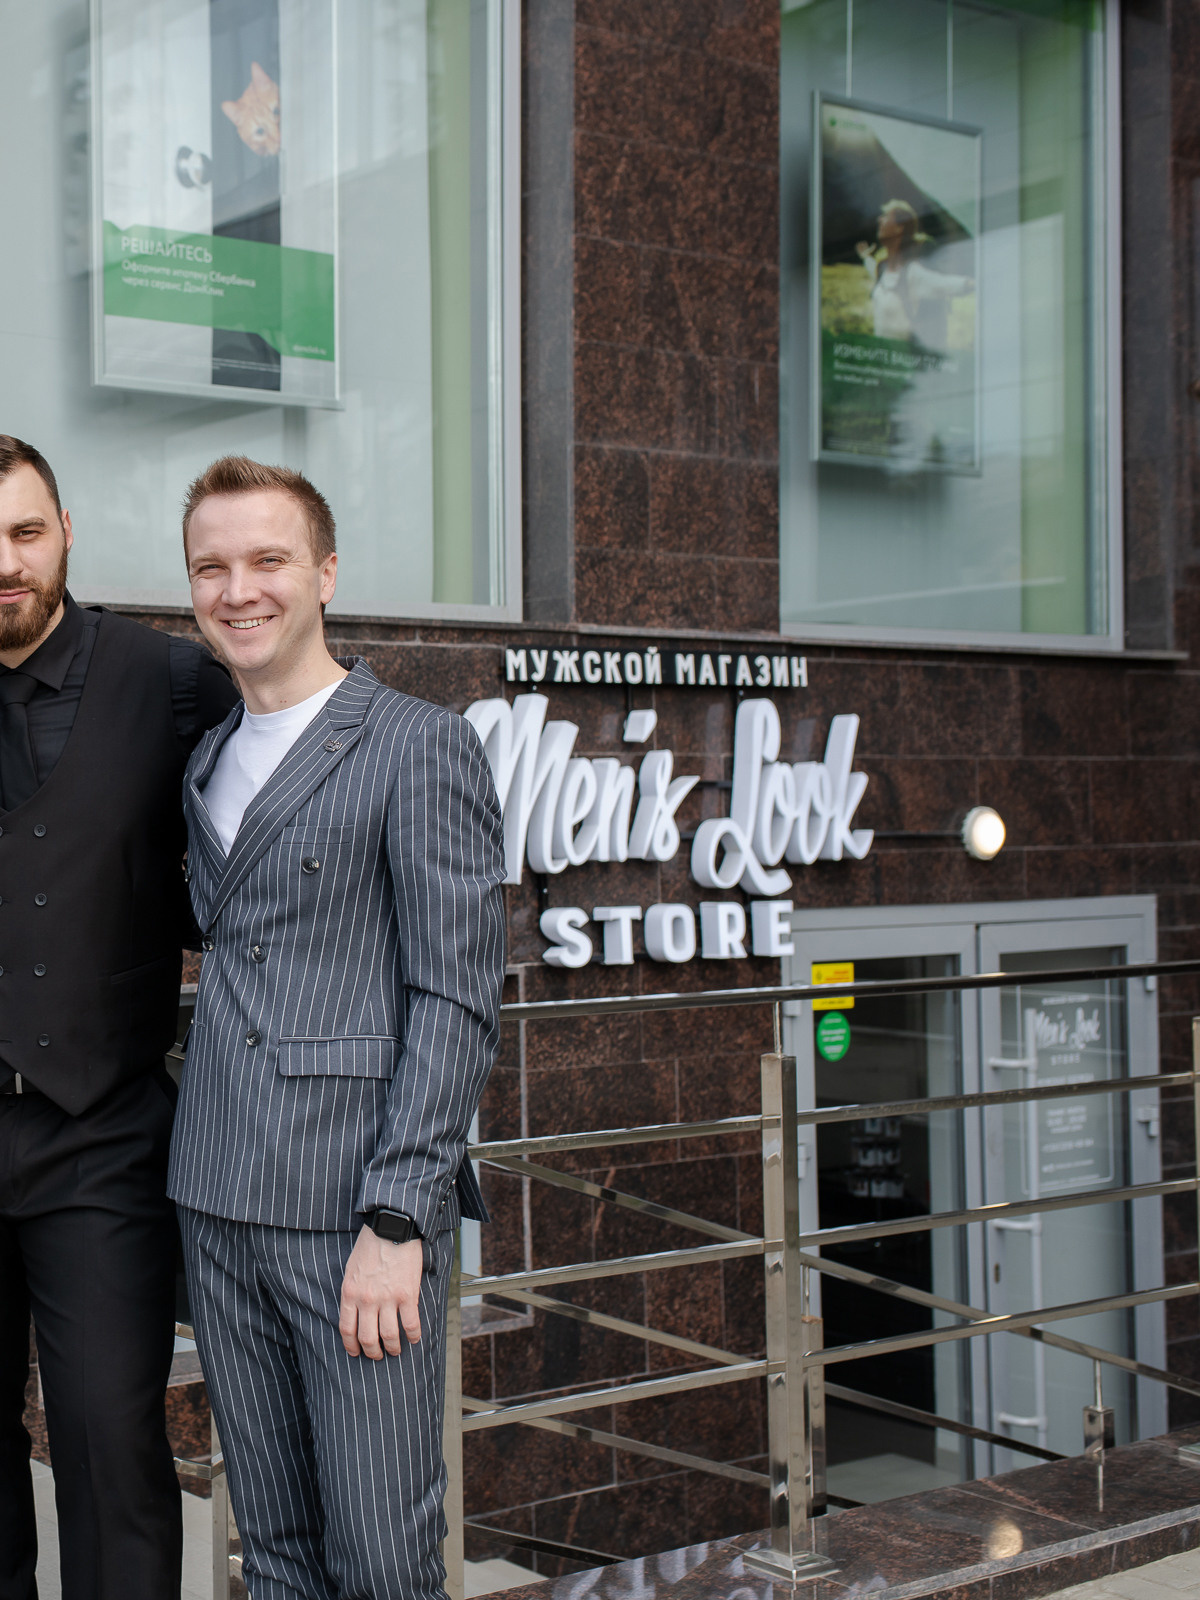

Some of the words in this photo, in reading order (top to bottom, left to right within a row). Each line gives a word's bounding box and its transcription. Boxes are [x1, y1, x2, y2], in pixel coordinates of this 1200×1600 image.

[120, 236, 213, 263] РЕШАЙТЕСЬ
[505, 646, 662, 683] МУЖСКОЙ
[675, 653, 808, 687] МАГАЗИН
[691, 698, 874, 896] Look
[540, 899, 795, 968] STORE
